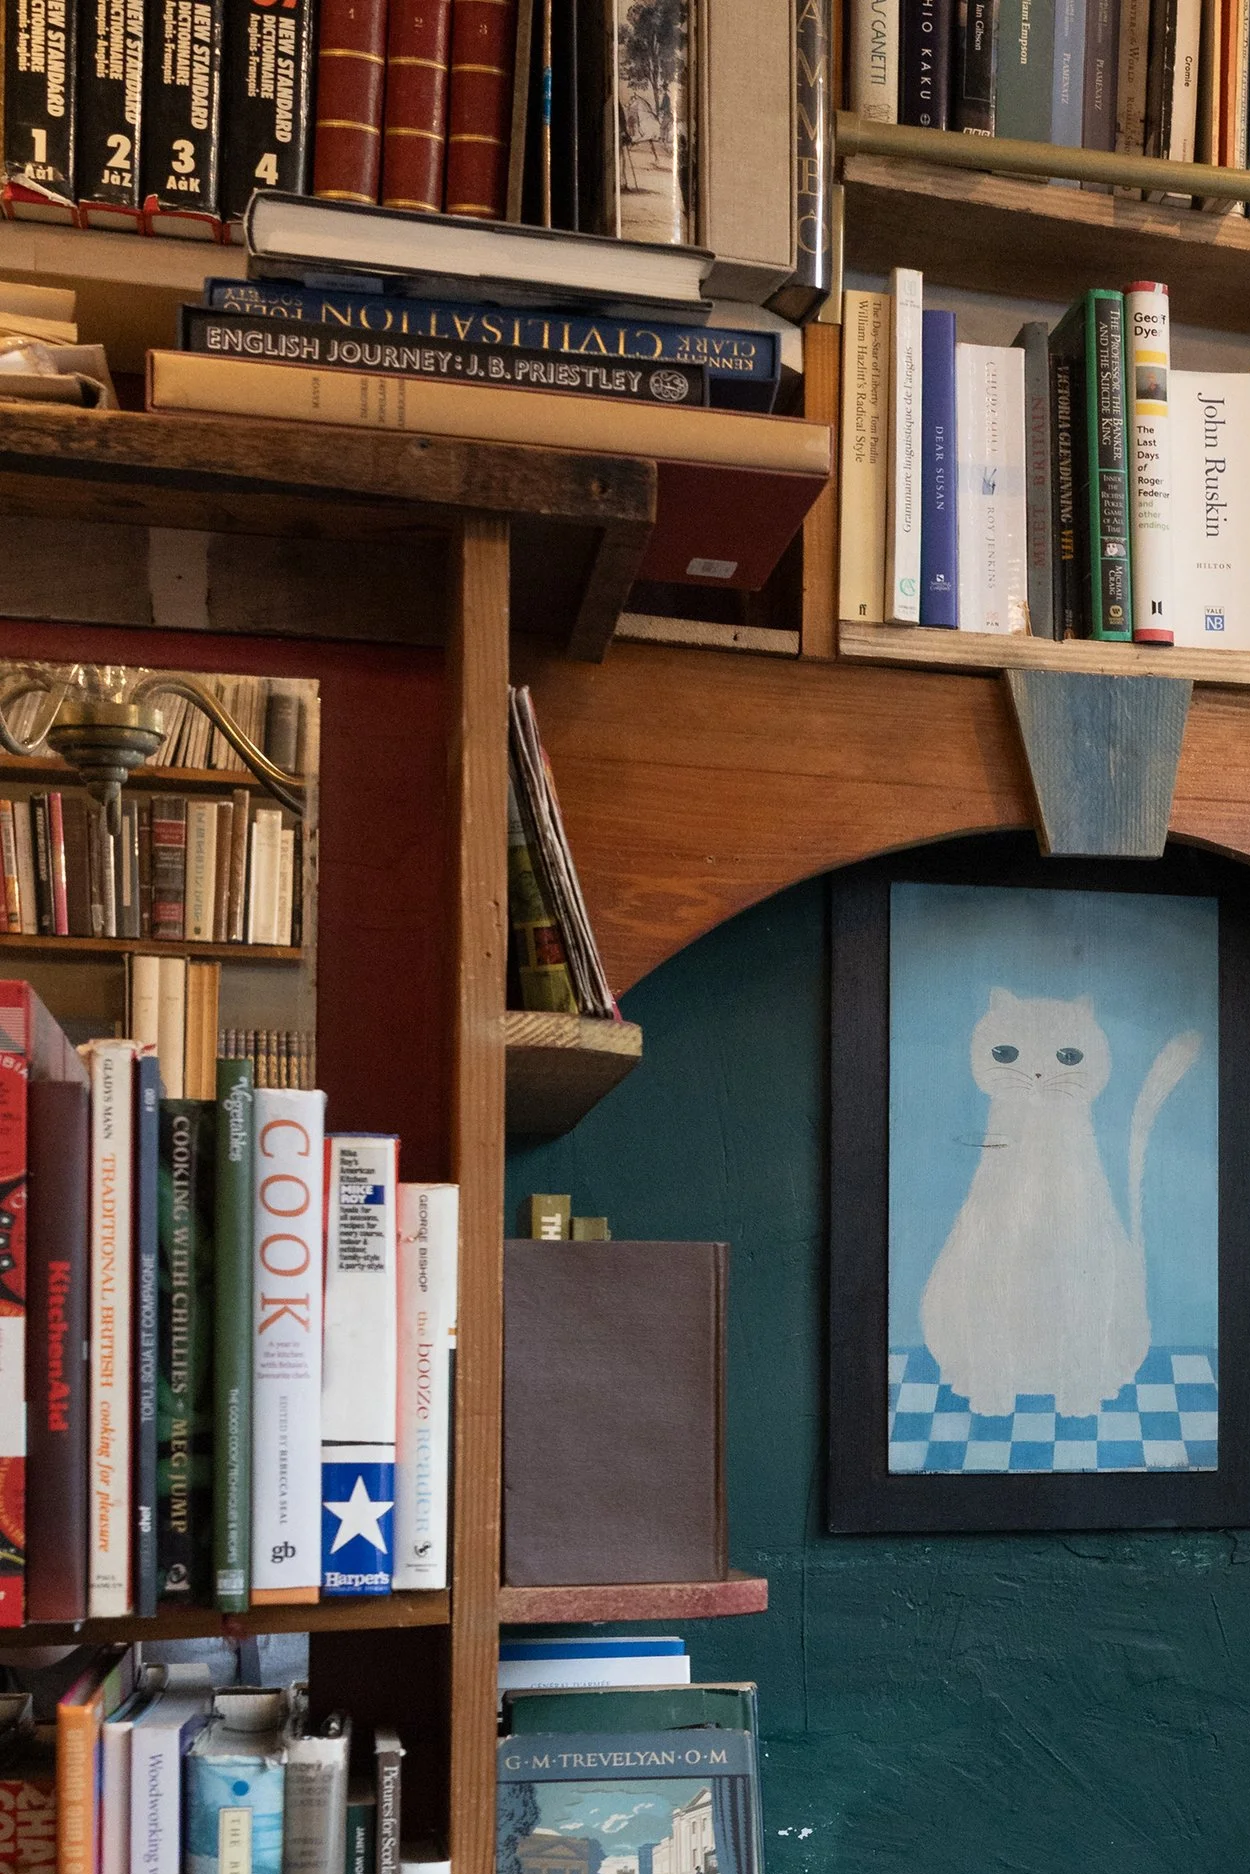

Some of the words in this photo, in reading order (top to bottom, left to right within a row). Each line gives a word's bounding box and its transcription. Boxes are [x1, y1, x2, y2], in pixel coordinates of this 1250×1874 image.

[277, 18, 295, 50] NEW
[1183, 55, 1194, 88] Cromie
[274, 52, 293, 142] STANDARD
[31, 129, 47, 161] 1
[106, 135, 133, 169] 2
[171, 140, 195, 173] 3
[254, 154, 279, 185] 4
[320, 302, 664, 359] CIVILISATION
[677, 335, 757, 356] CLARK
[206, 326, 321, 360] ENGLISH
[515, 361, 642, 393] PRIESTLEY
[1136, 426, 1155, 435] The
[1136, 438, 1157, 447] Last
[1197, 392, 1226, 450] John
[1137, 450, 1160, 461] Days
[1138, 476, 1164, 487] Roger
[1138, 489, 1170, 499] Federer
[1203, 457, 1229, 538] Ruskin
[1196, 562, 1232, 570] HILTON
[228, 1076, 251, 1162] Vegetables
[100, 1153, 117, 1303] TRADITIONAL
[259, 1119, 312, 1337] COOK
[47, 1260, 70, 1432] KitchenAid
[100, 1307, 115, 1389] BRITISH
[98, 1400, 113, 1461] cooking
[98, 1495, 112, 1553] pleasure
[147, 1753, 161, 1867] Woodworking
